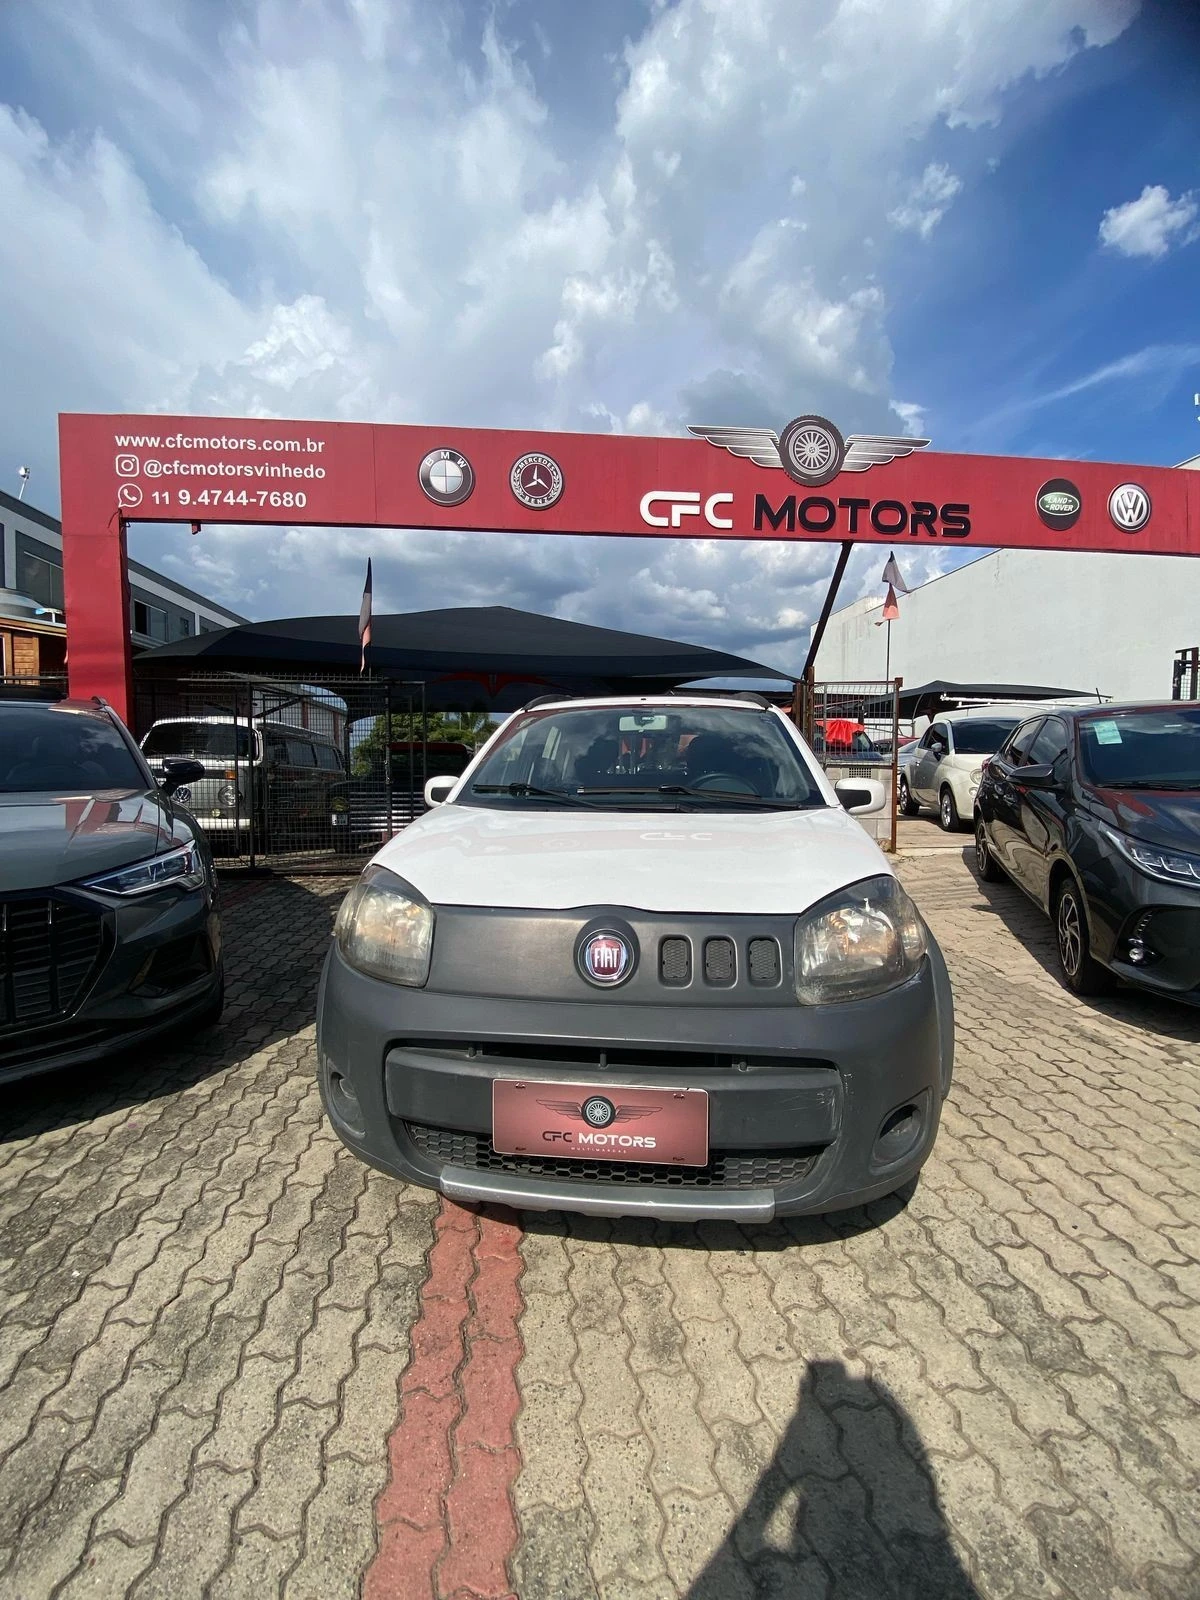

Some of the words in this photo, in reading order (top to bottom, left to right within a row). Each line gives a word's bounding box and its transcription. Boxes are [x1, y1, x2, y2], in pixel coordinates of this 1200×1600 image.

[115, 433, 325, 453] www.cfcmotors.com.br
[143, 459, 326, 479] @cfcmotorsvinhedo
[425, 451, 467, 468] BMW
[518, 456, 556, 472] MERCEDES
[151, 491, 170, 505] 11
[178, 489, 307, 508] 9.4744-7680
[524, 495, 549, 505] BENZ
[639, 490, 734, 529] CFC
[753, 493, 972, 538] MOTORS
[594, 947, 620, 968] FIAT
[542, 1130, 573, 1143] CFC
[578, 1132, 657, 1149] MOTORS
